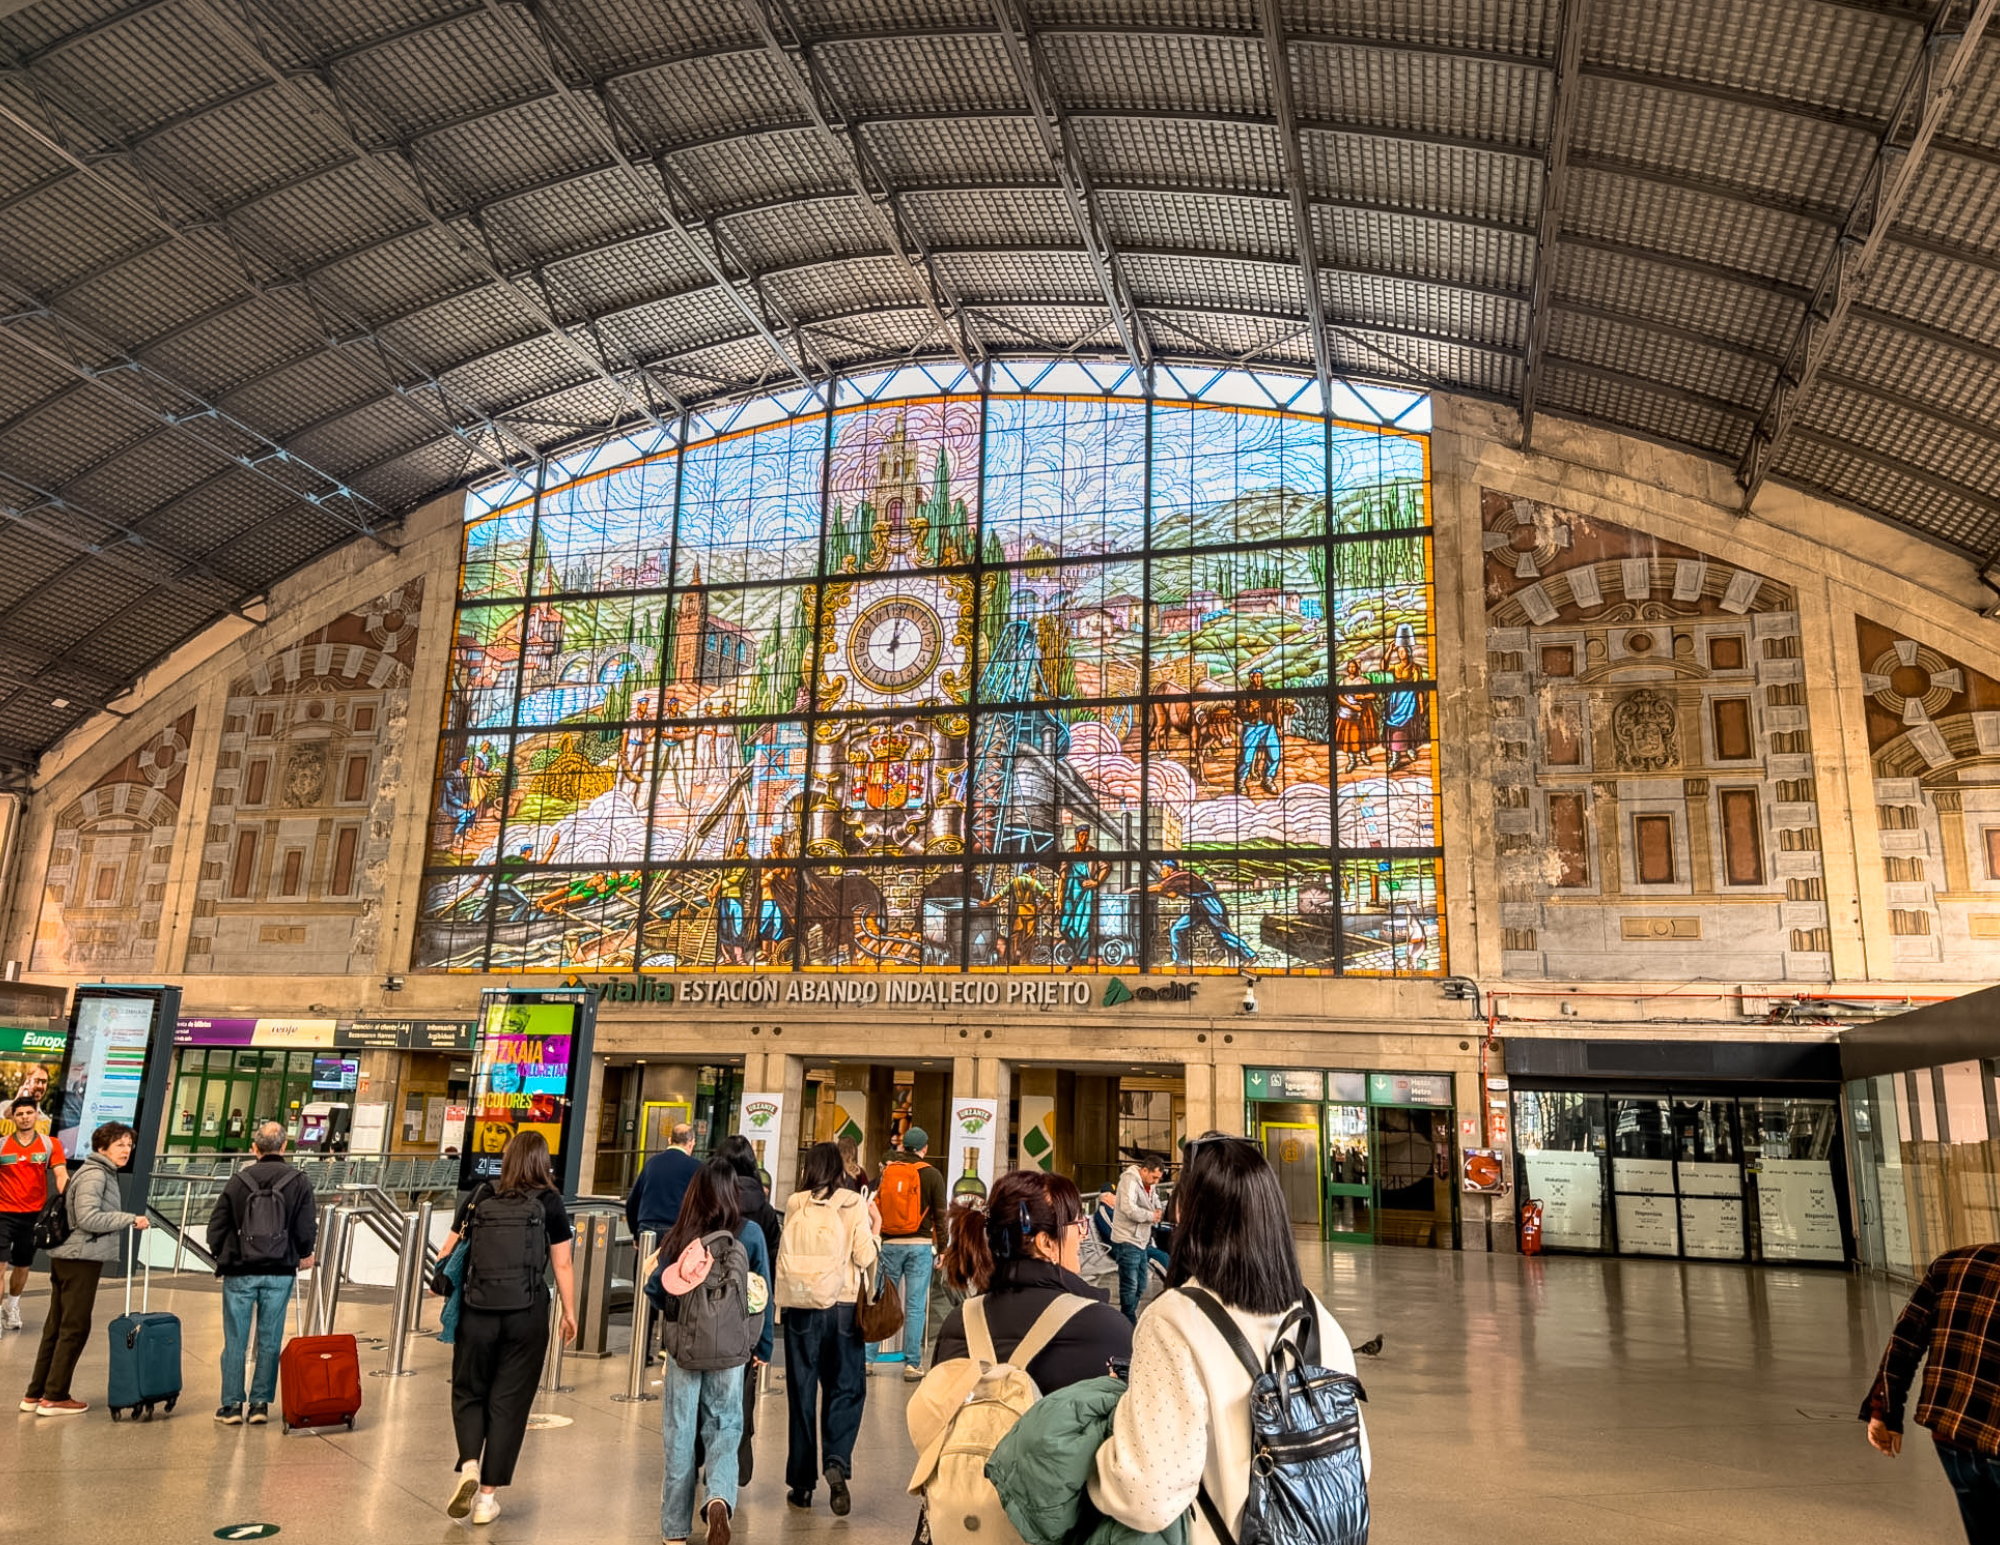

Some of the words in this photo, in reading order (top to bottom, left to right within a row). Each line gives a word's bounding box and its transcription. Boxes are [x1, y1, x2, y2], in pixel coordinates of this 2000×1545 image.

[920, 620, 928, 630] 2
[863, 627, 871, 636] 10
[859, 641, 866, 651] 9
[924, 638, 931, 647] 3
[862, 657, 868, 668] 8
[919, 654, 926, 664] 4
[874, 670, 881, 680] 7
[889, 673, 896, 682] 6
[597, 975, 672, 1002] vialia
[679, 975, 778, 1003] ESTACIÓN
[785, 980, 877, 1002] ABANDO
[885, 980, 1000, 1004] INDALECIO
[1006, 981, 1090, 1005] PRIETO
[1138, 981, 1201, 1001] adif
[271, 1026, 298, 1036] renfe
[487, 1094, 533, 1109] COLORES
[748, 1103, 776, 1113] URZANTE
[960, 1109, 990, 1119] URZANTE
[478, 1158, 488, 1169] 21
